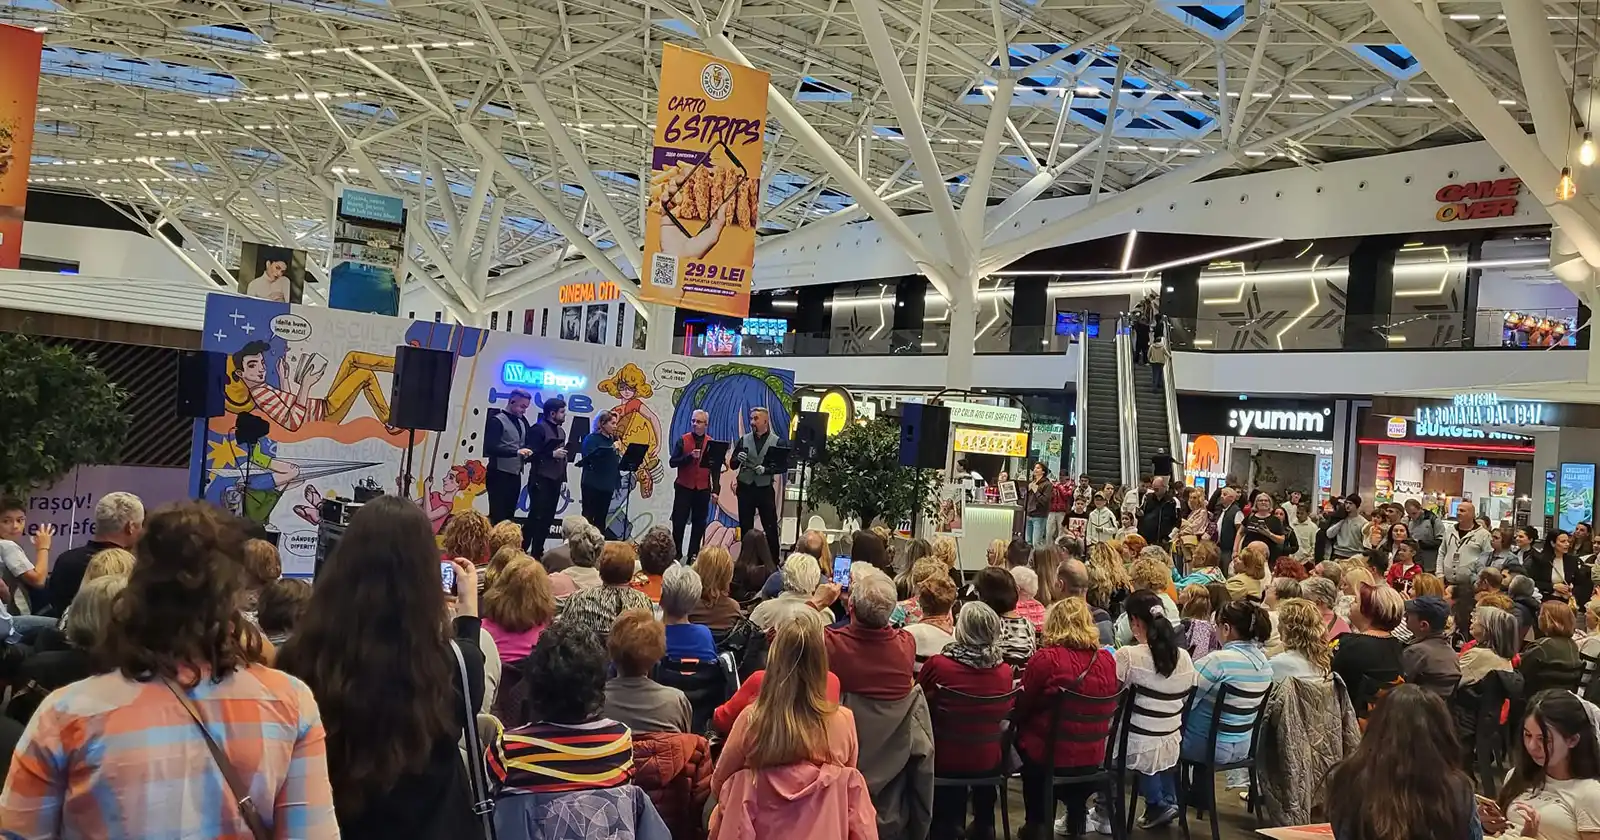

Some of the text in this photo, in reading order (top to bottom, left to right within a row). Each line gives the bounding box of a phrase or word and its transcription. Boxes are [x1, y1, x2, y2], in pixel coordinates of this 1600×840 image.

[668, 96, 706, 113] CARTO
[664, 114, 760, 145] 6 STRIPS
[1436, 178, 1522, 202] GAME
[1436, 199, 1518, 222] OVER
[685, 263, 745, 282] 29.9 LEI
[559, 283, 597, 303] CINEMA
[1453, 393, 1499, 407] GELATERIA
[1416, 408, 1431, 424] LA
[1434, 405, 1481, 425] ROMANA
[29, 493, 92, 515] rașov!
